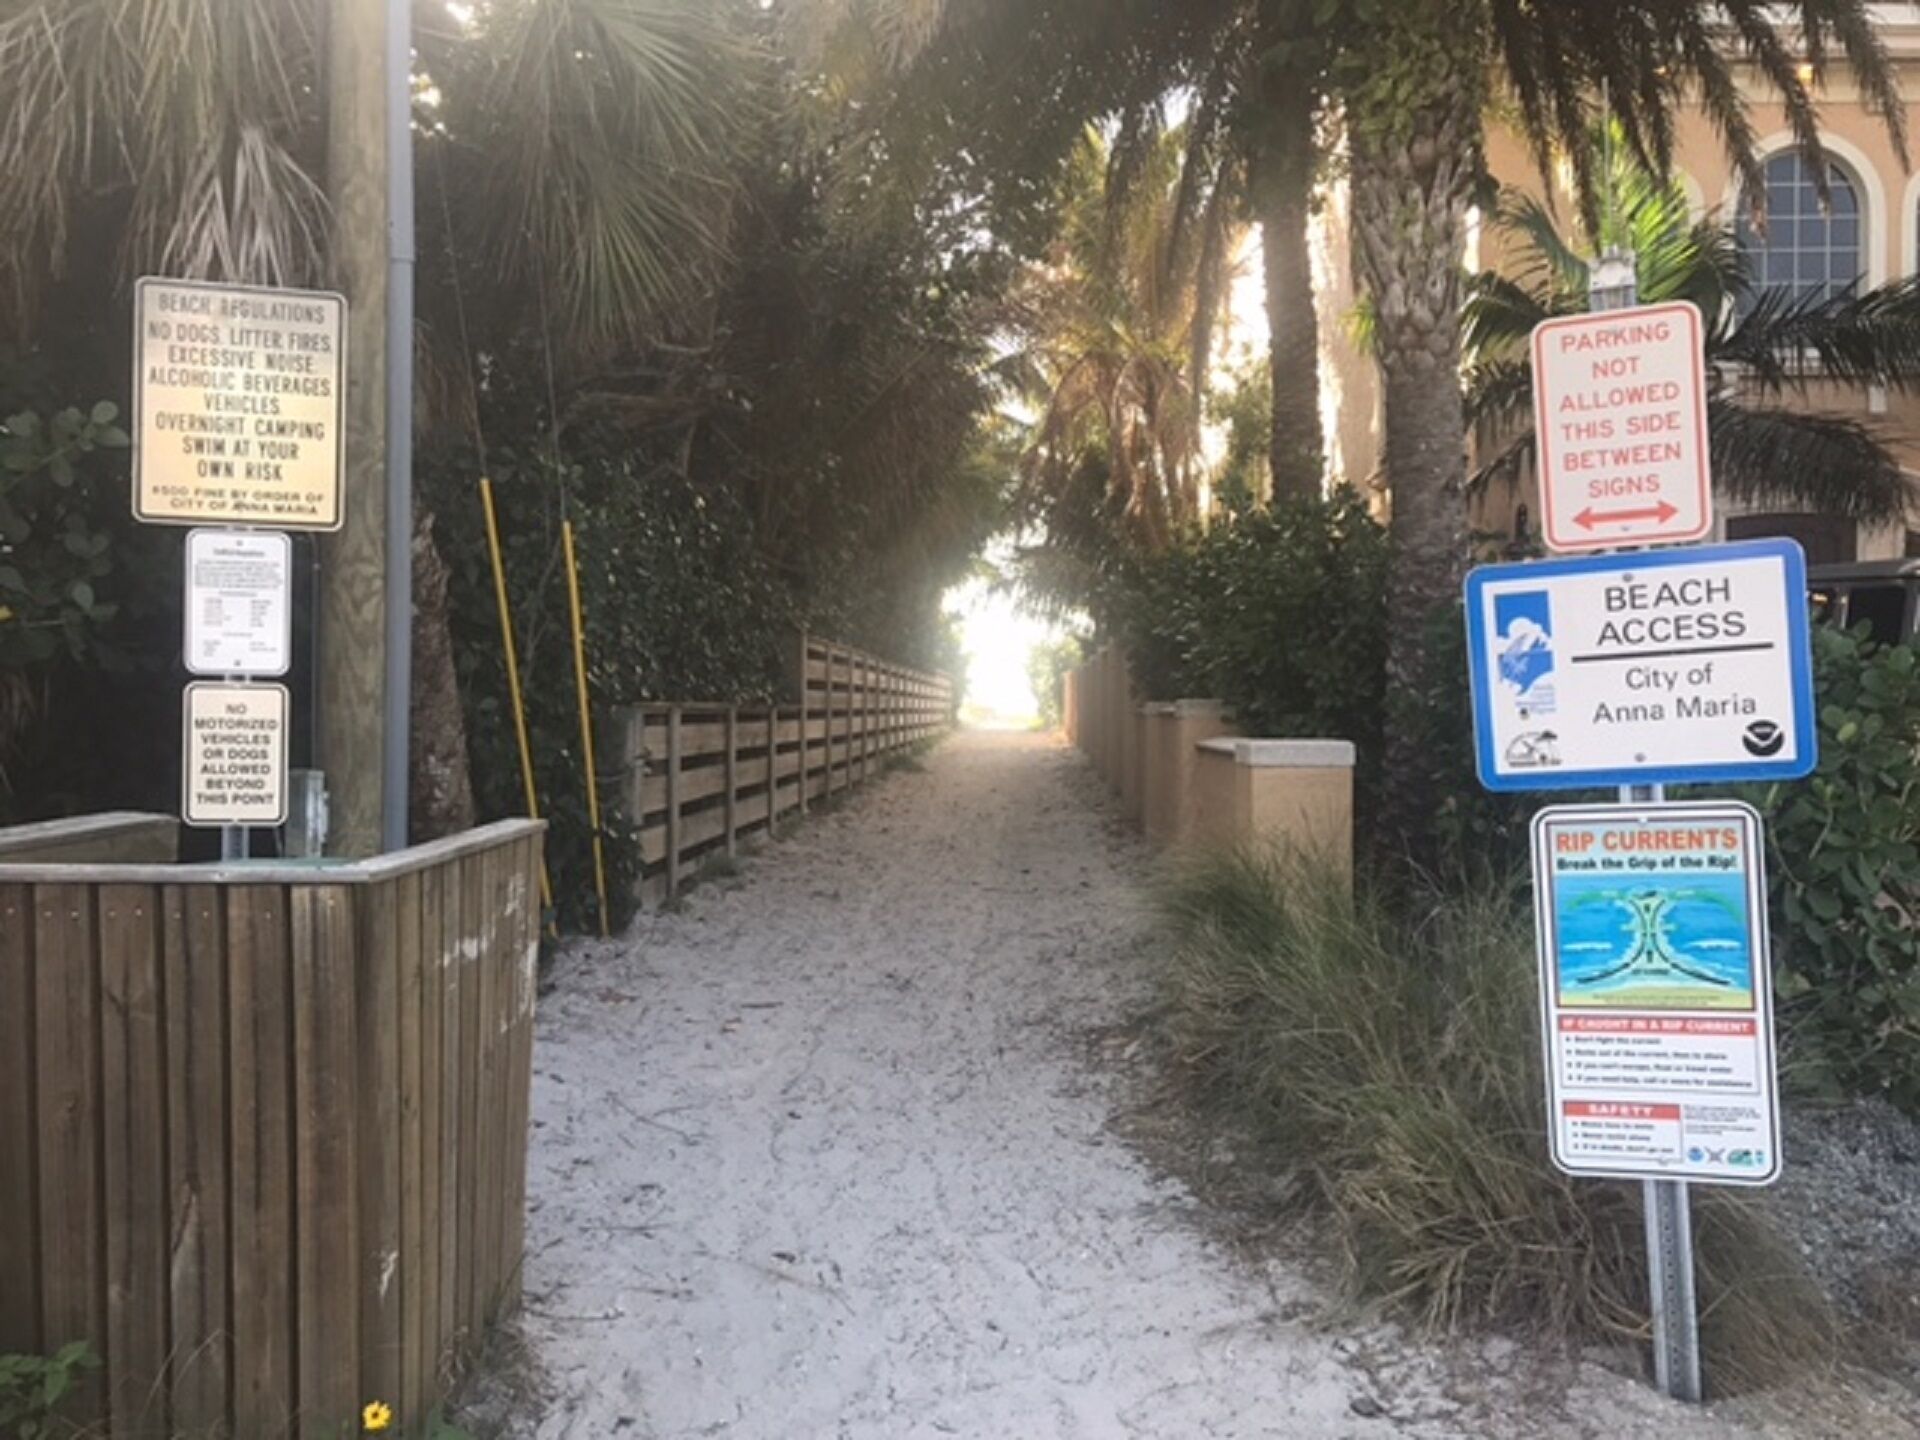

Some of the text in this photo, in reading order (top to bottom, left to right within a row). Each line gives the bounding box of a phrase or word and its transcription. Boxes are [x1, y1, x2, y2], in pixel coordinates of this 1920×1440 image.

[159, 294, 325, 324] BEACH REGULATIONS
[148, 321, 171, 341] NO
[1561, 323, 1670, 353] PARKING
[169, 346, 254, 369] EXCESSIVE
[1592, 356, 1641, 379] NOT
[149, 369, 330, 397] ALCOHOLIC BEVERAGES
[204, 394, 280, 415] VEHICLES
[1560, 382, 1680, 412] ALLOWED
[156, 412, 325, 440] OVERNIGHT CAMPING
[1561, 411, 1681, 441] THIS SIDE
[183, 436, 299, 459] SWIM AT YOUR
[1564, 442, 1682, 471] BETWEEN
[198, 460, 283, 481] OWN RISK
[194, 488, 226, 498] FINE
[231, 489, 248, 499] BY
[252, 490, 301, 501] ORDER
[306, 492, 324, 502] OF
[1589, 474, 1660, 498] SIGNS
[170, 498, 318, 514] CITY OF ANNA MARIA
[1605, 577, 1731, 612] BEACH
[1597, 611, 1746, 646] ACCESS
[1625, 662, 1714, 691] City of
[226, 704, 247, 714] NO
[1593, 693, 1756, 724] Anna Maria
[195, 718, 278, 730] MOTORIZED
[201, 734, 271, 745] VEHICLES
[203, 748, 268, 759] OR DOGS
[201, 764, 271, 775] ALLOWED
[206, 779, 265, 789] BEYOND
[197, 793, 274, 804] THIS POINT
[1556, 828, 1737, 853] RIP CURRENTS
[1557, 855, 1737, 870] Break the Grip of the Rip!
[1588, 1103, 1653, 1116] SAFETY
